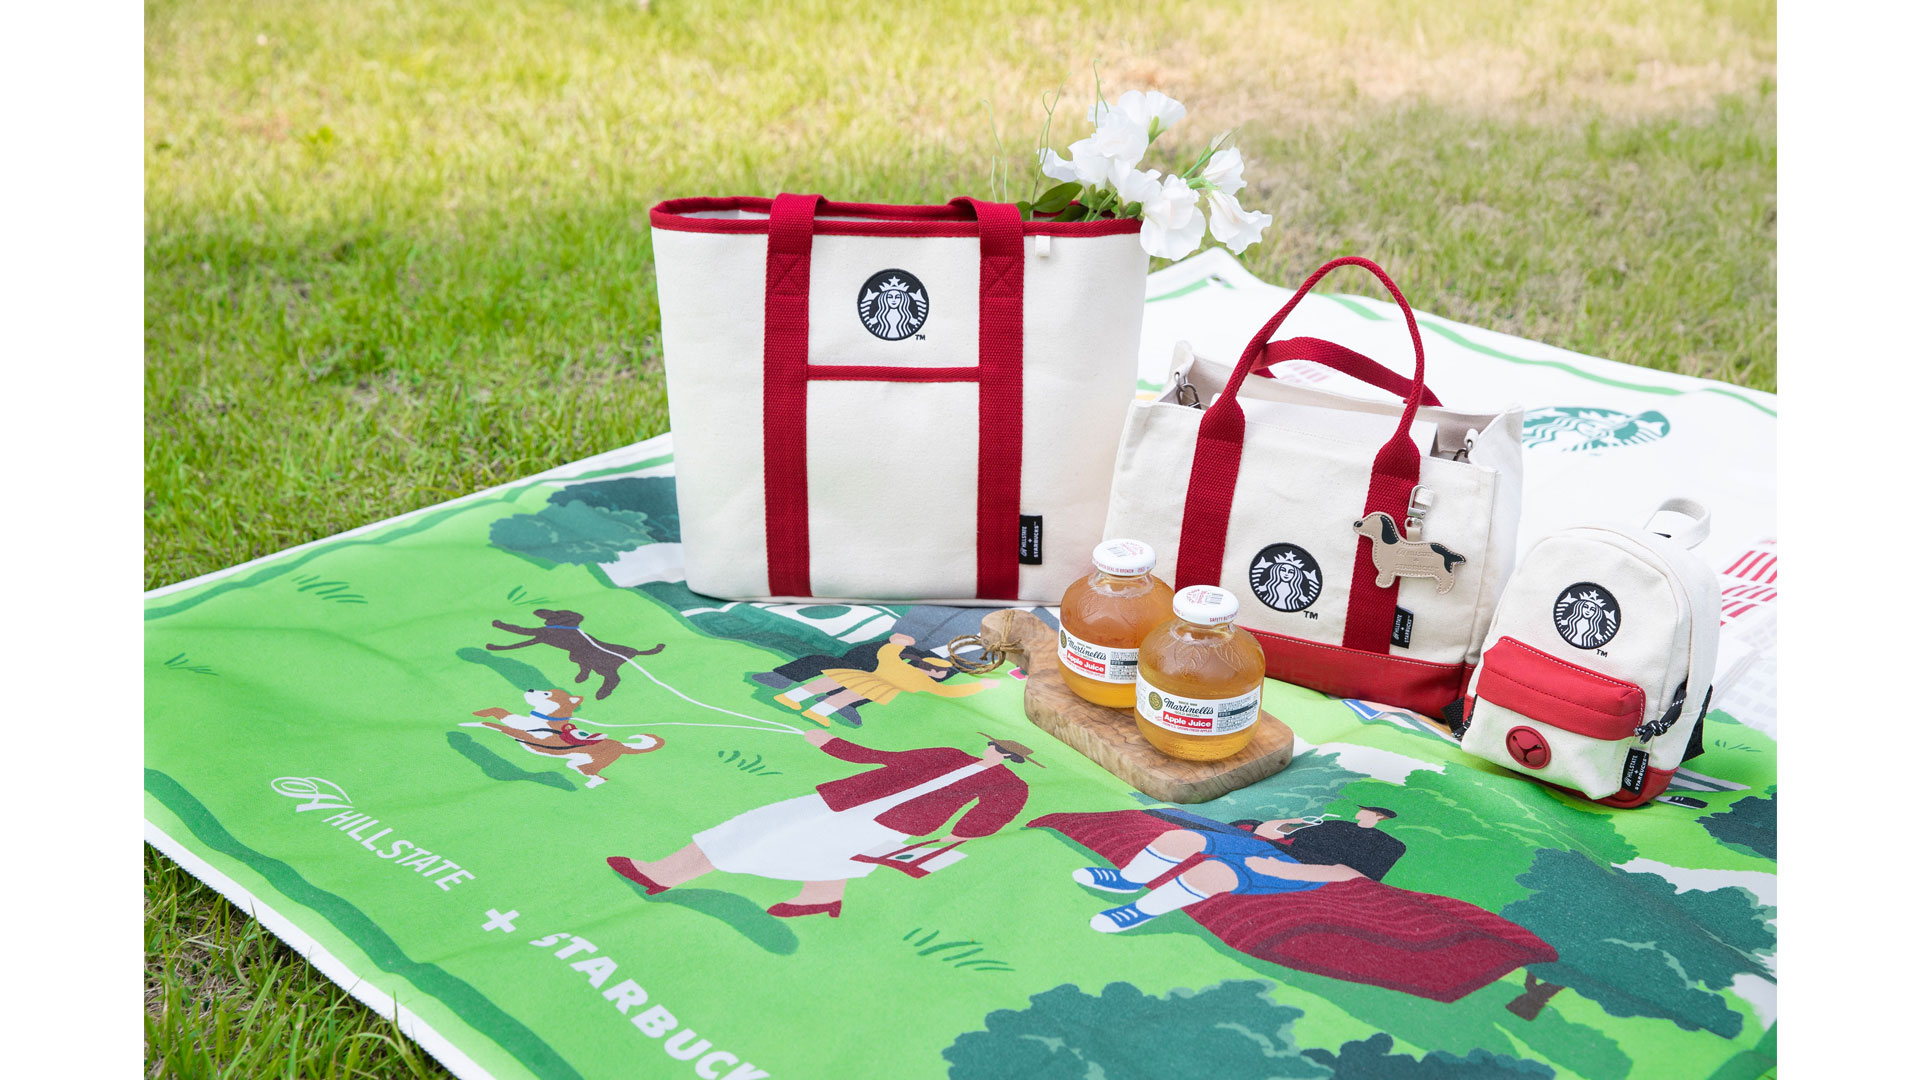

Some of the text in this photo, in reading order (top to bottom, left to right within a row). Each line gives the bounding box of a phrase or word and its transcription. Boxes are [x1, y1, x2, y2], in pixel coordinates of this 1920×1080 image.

[1067, 653, 1084, 667] Apple
[1084, 662, 1105, 673] Juice
[1163, 697, 1214, 715] Martinelli's
[1164, 713, 1187, 726] Apple
[1188, 719, 1212, 728] Juice
[321, 810, 476, 891] HILLSTATE
